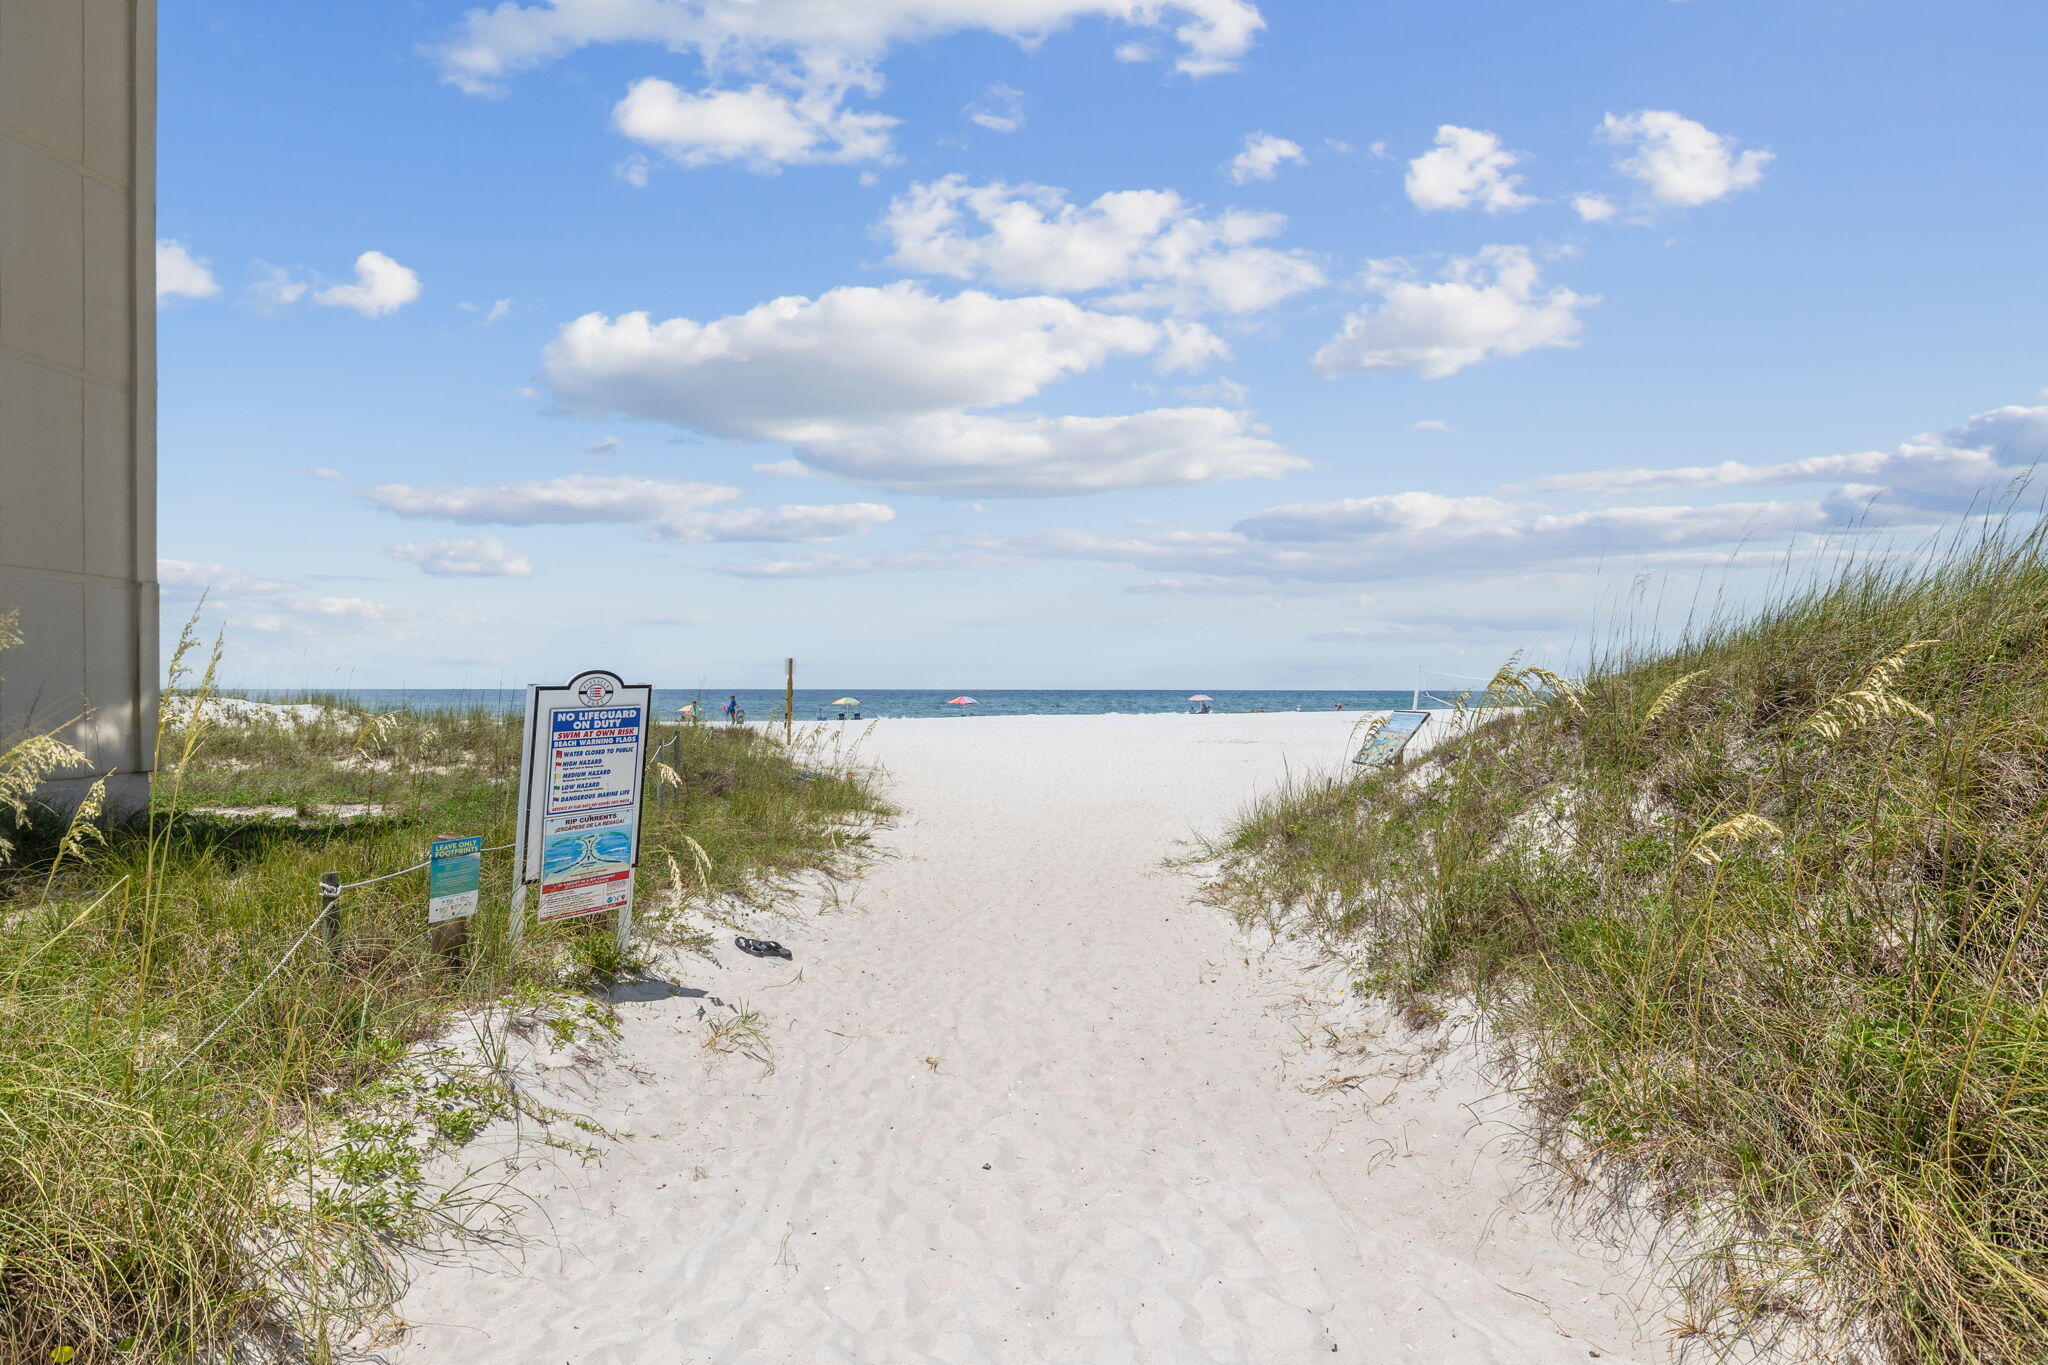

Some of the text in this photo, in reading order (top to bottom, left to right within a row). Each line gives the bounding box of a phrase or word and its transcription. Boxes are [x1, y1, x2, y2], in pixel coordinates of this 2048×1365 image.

[557, 710, 637, 722] NO LIFEGUARD
[573, 719, 622, 729] ON DUTY
[557, 727, 635, 740] SWIM AT OWN RISK
[580, 738, 614, 746] WARNING
[615, 735, 637, 743] FLAGS
[562, 771, 586, 779] MEDIUM
[576, 781, 600, 789] HAZARD
[560, 793, 596, 802] DANGEROUS
[597, 790, 618, 798] MARINE
[579, 813, 617, 823] CURRENTS
[435, 840, 477, 851] LEAVE ONLY
[435, 846, 478, 858] FOOTPRINTS
